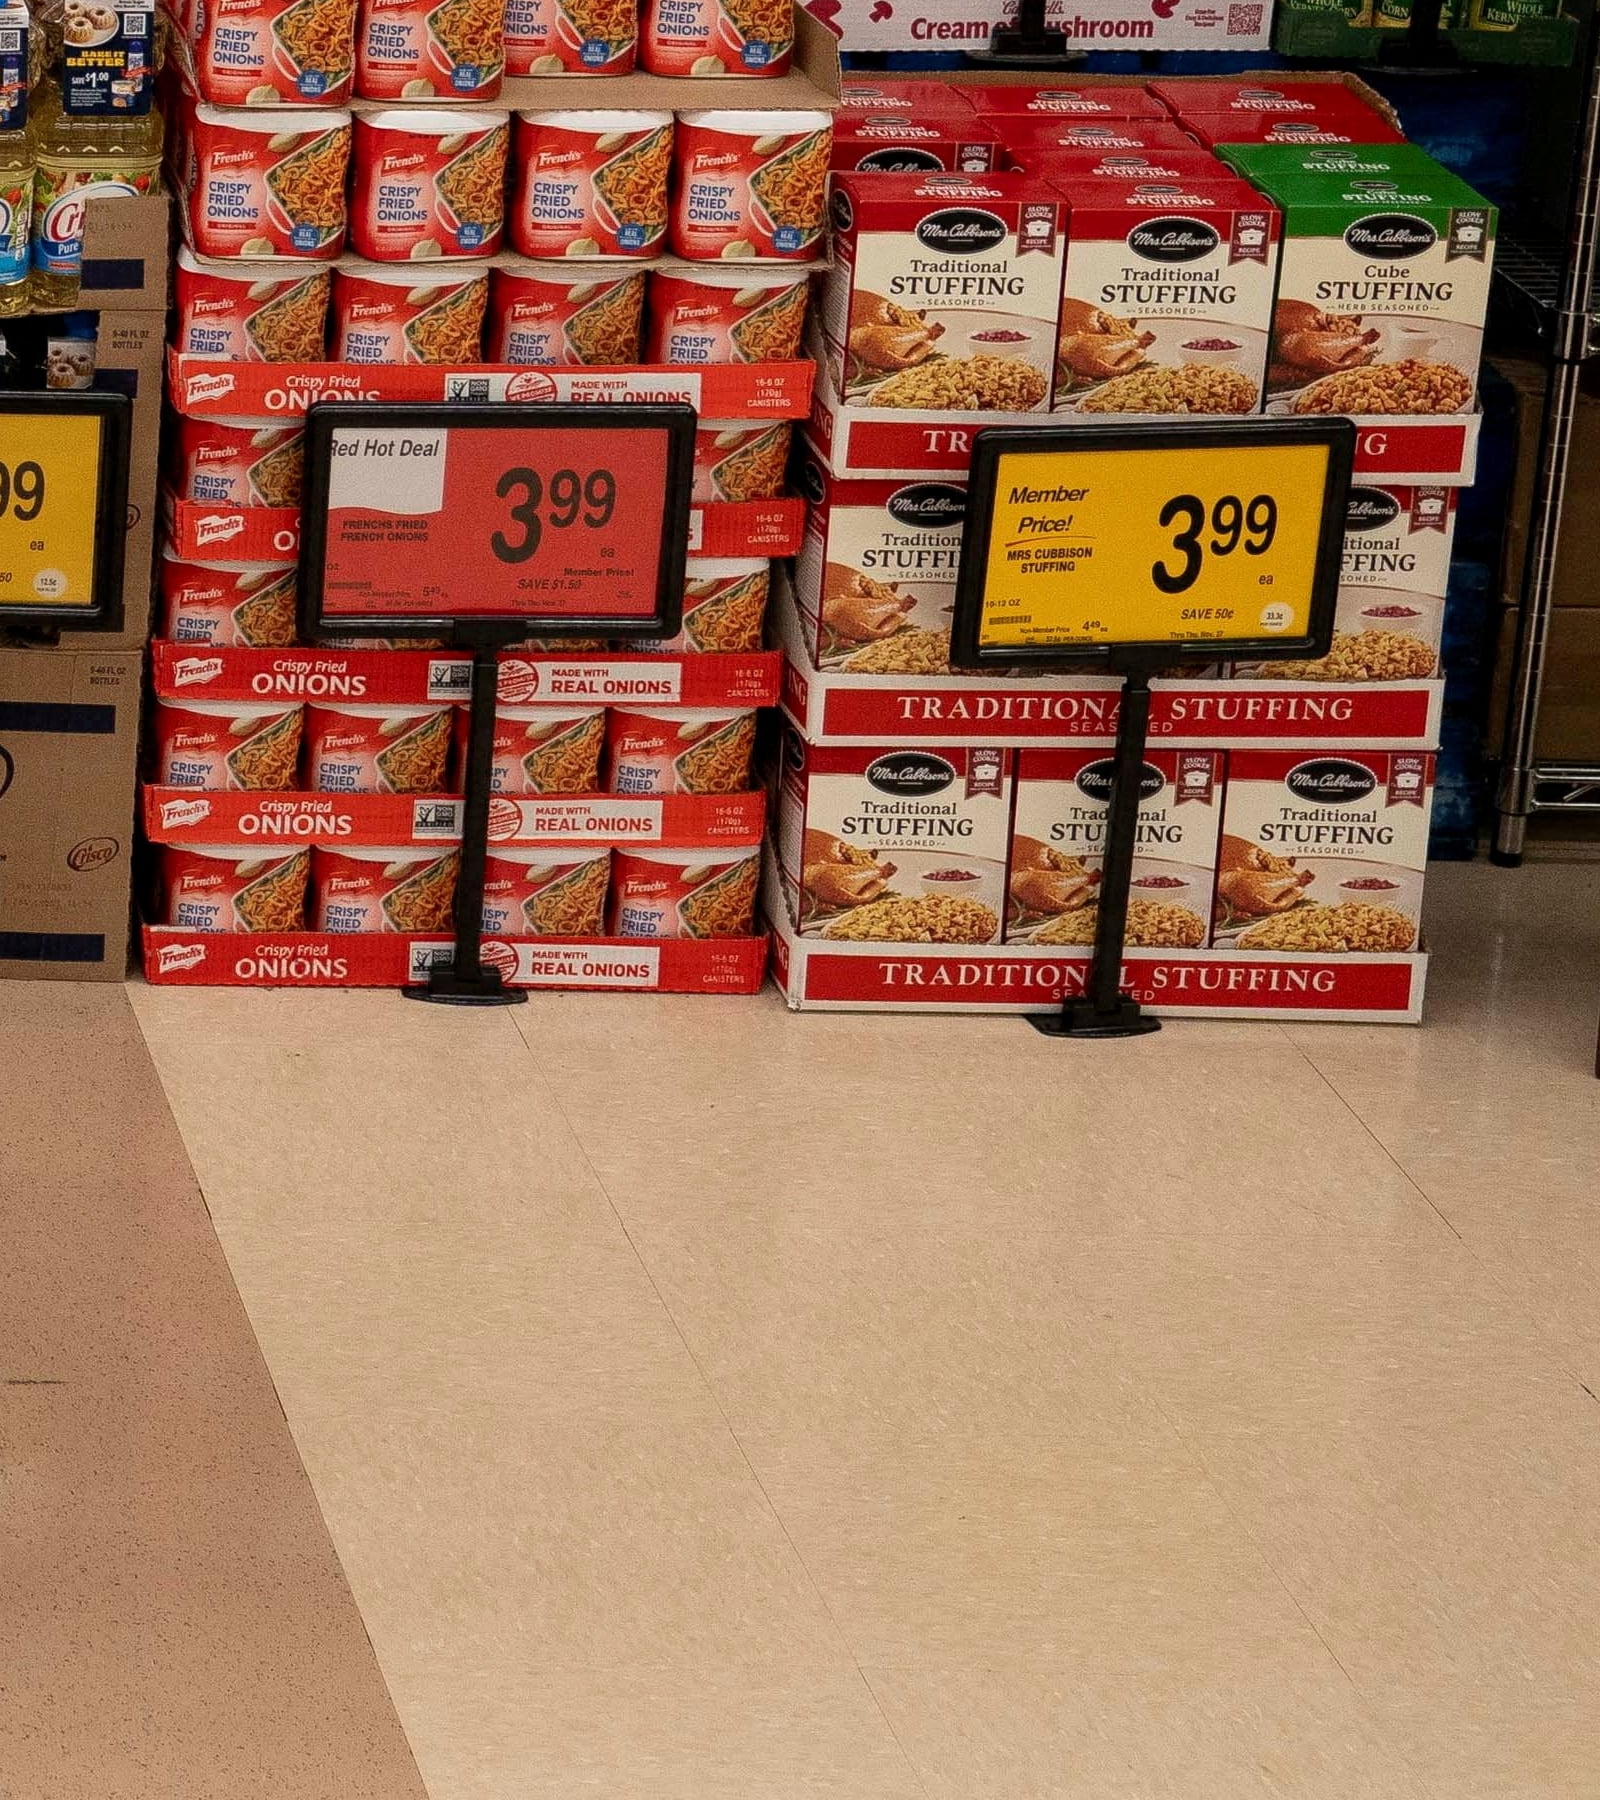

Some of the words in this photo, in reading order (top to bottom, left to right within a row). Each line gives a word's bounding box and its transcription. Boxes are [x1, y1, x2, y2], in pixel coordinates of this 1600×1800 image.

[215, 28, 258, 41] CRISPY
[215, 40, 250, 52] FRIED
[213, 51, 265, 65] ONIONS
[1161, 232, 1213, 246] Cubbison's
[1122, 268, 1219, 281] Traditional
[1101, 285, 1236, 303] STUFFING
[1138, 307, 1196, 315] SEASONED
[364, 440, 395, 457] Hot
[400, 439, 440, 457] Deal
[1007, 549, 1032, 561] MRS
[1034, 546, 1093, 559] CUBBISON
[1020, 561, 1075, 573] STUFFING
[251, 673, 367, 696] ONIONS
[551, 679, 594, 695] REAL
[596, 679, 672, 696] ONIONS
[1168, 697, 1354, 722] STUFFING
[878, 962, 1137, 991] TRADITIONL
[1150, 966, 1336, 992] STUFFING
